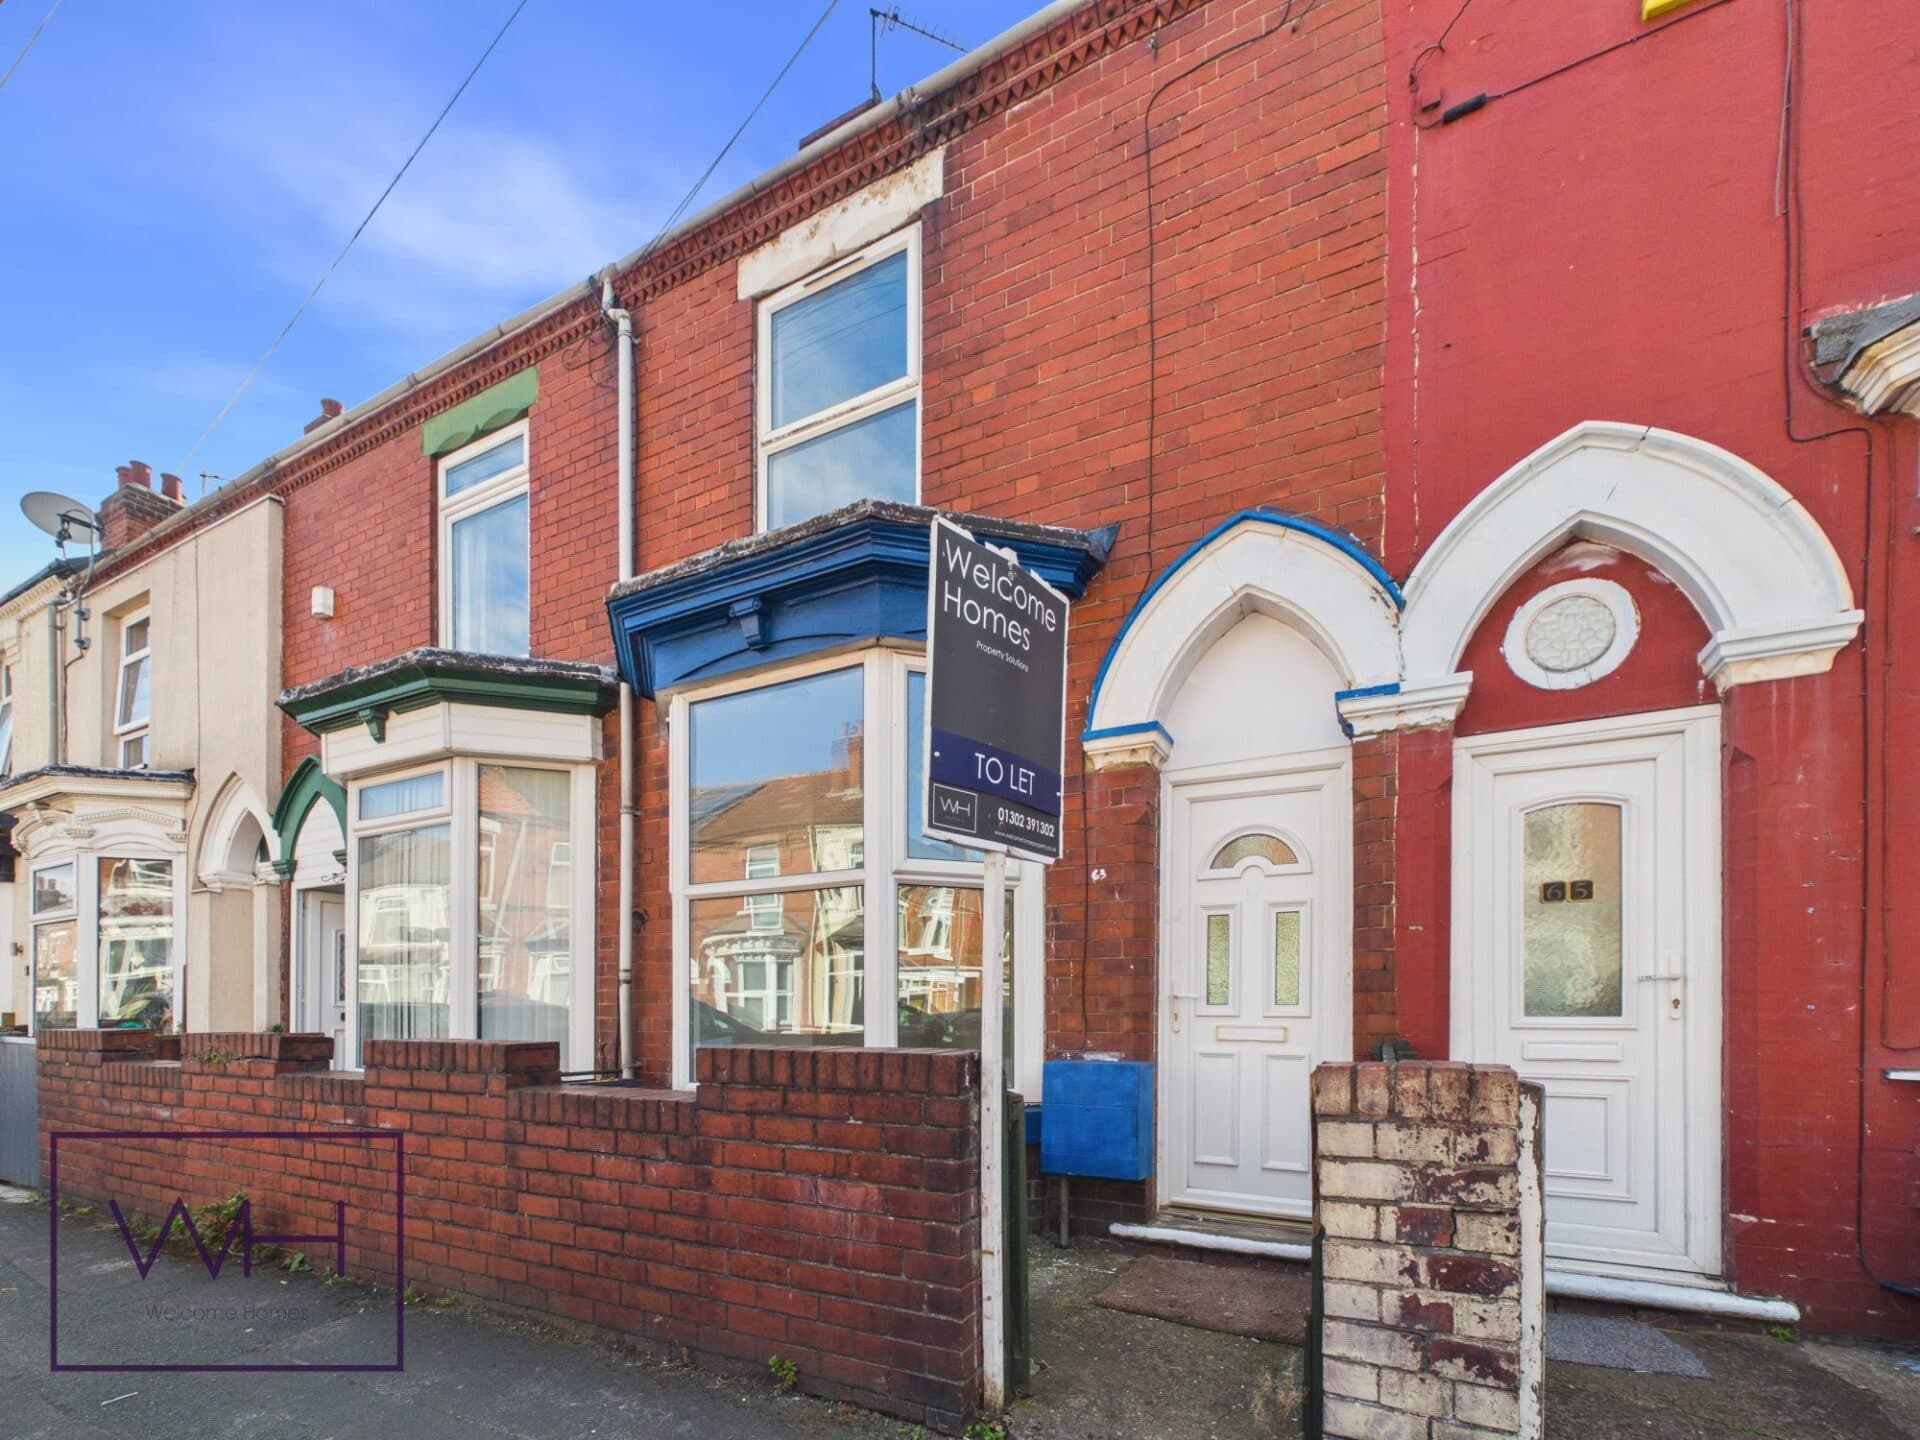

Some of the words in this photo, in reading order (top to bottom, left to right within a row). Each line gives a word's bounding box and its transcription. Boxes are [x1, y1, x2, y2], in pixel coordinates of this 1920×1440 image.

[945, 539, 1056, 632] Welcome
[944, 580, 1030, 651] Homes
[976, 640, 1005, 661] Property
[975, 752, 1004, 784] TO
[1010, 764, 1035, 796] LET
[997, 807, 1025, 828] 01302
[1025, 816, 1055, 838] 391302
